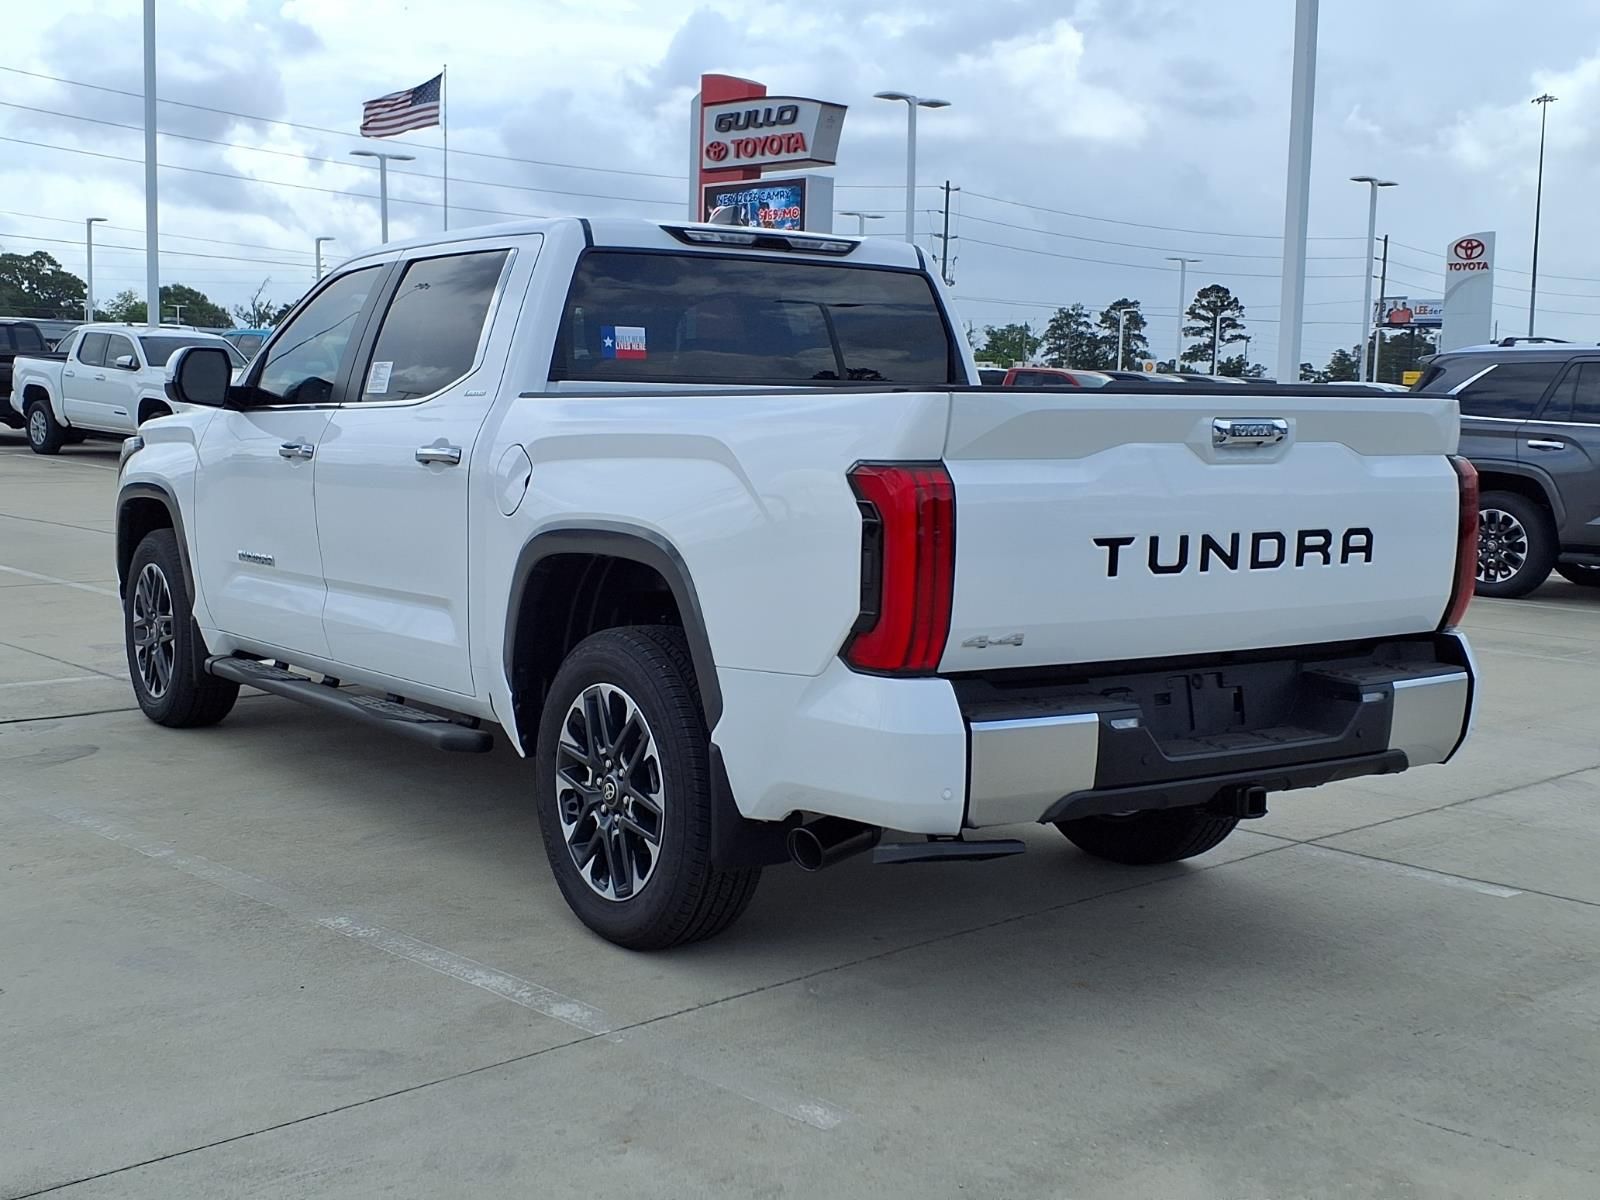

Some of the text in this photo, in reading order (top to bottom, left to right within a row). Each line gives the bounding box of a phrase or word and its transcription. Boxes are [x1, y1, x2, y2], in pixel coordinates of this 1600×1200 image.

[715, 104, 799, 133] GULLO
[730, 132, 807, 159] TOYOTA
[759, 188, 791, 201] CAMRY
[1448, 261, 1489, 271] TOYOTA
[1234, 424, 1272, 436] TOYOTA
[1092, 527, 1374, 577] TUNDRA
